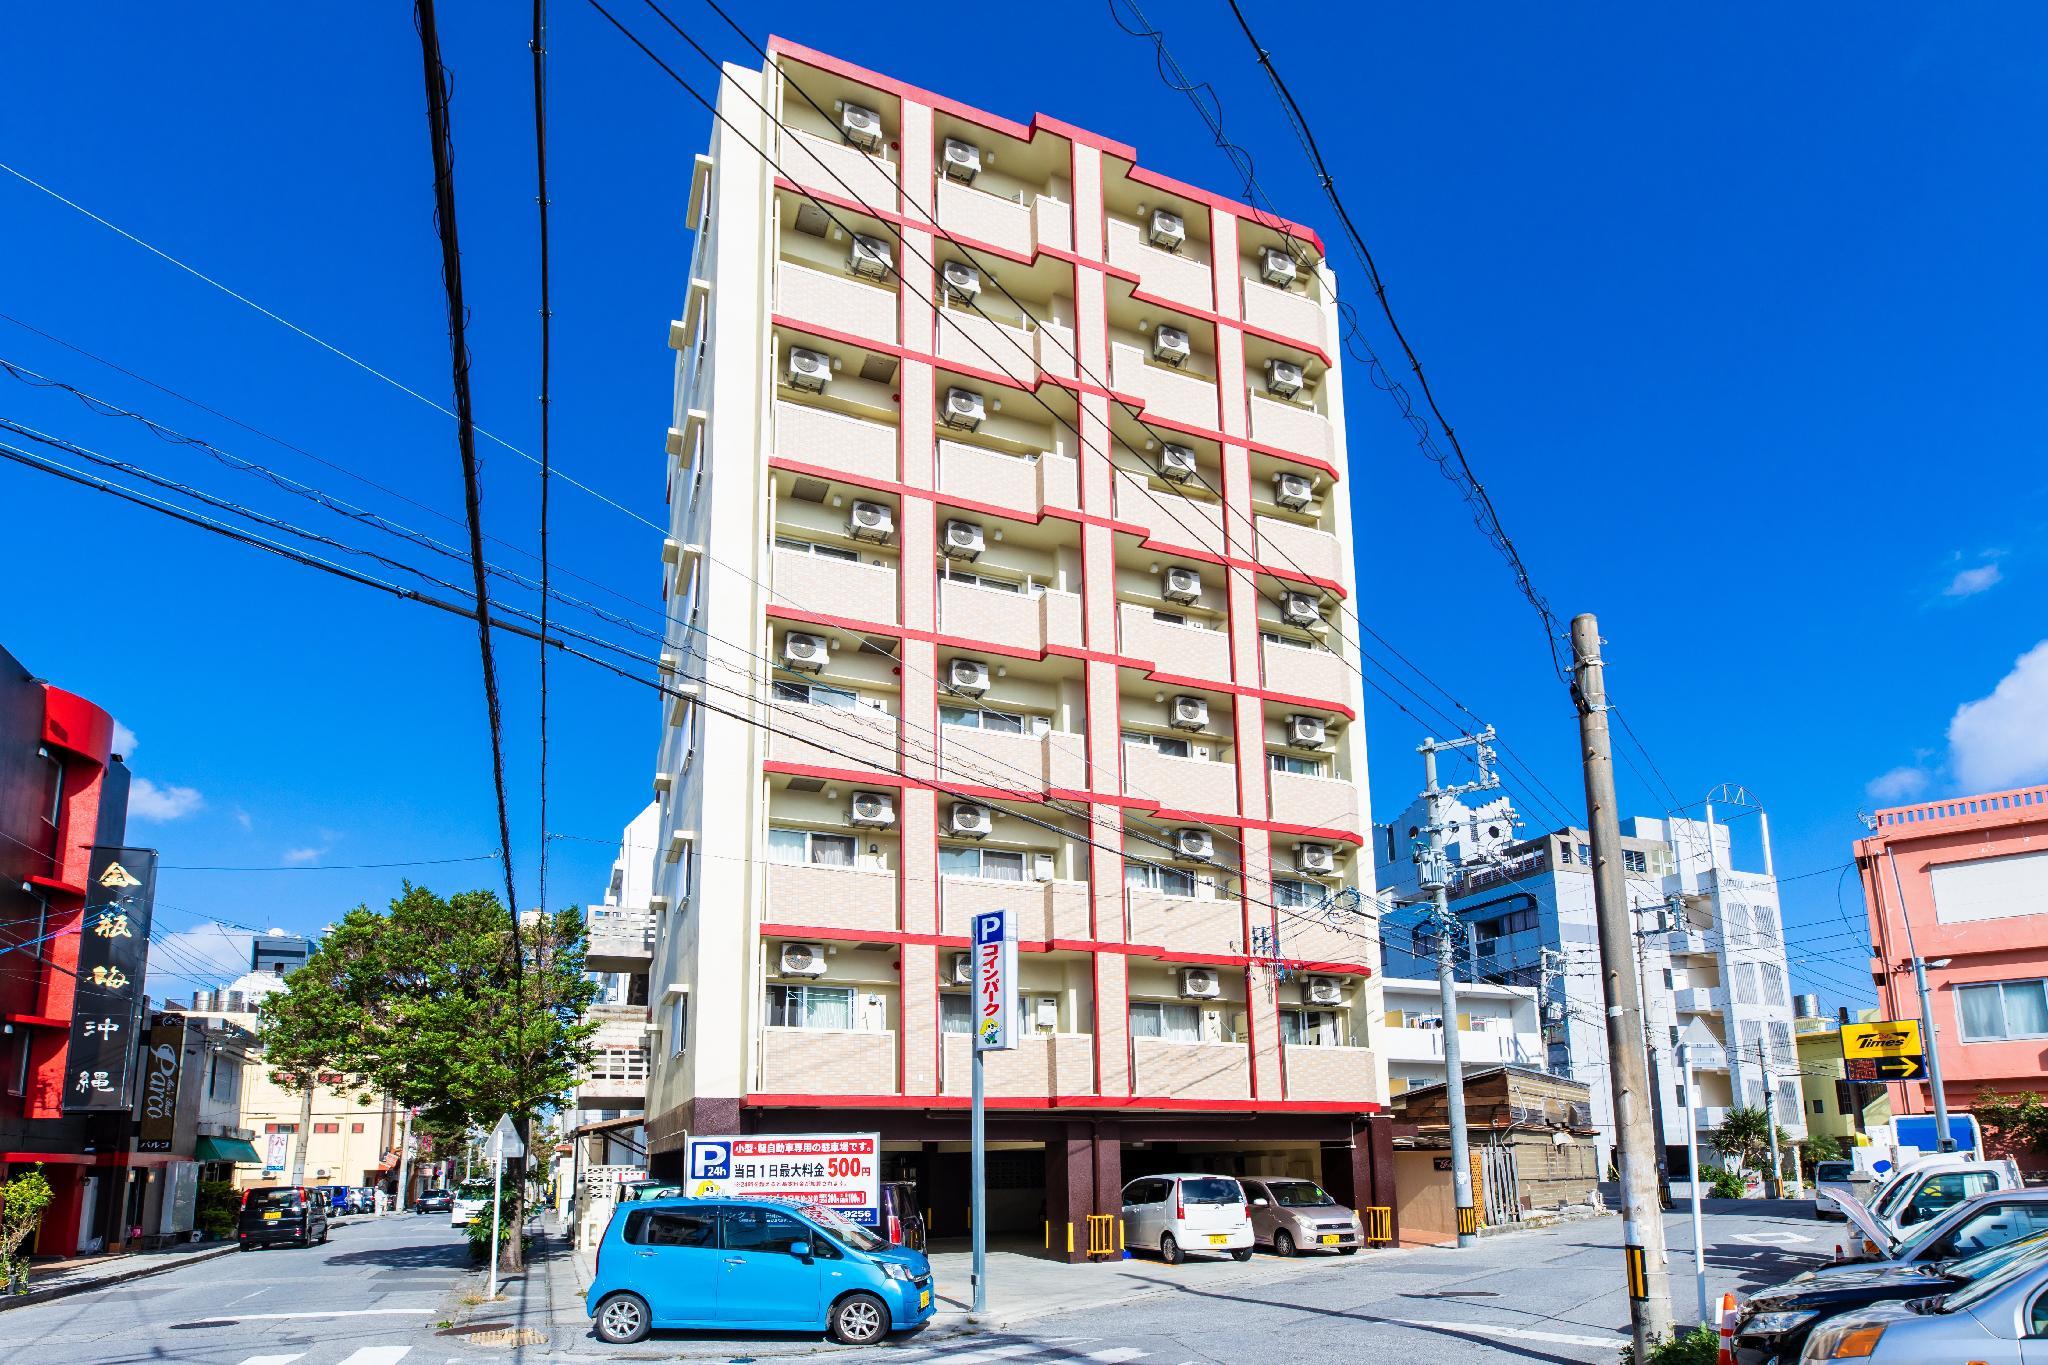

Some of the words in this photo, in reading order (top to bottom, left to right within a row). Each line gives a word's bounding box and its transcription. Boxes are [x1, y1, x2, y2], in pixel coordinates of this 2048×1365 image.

[981, 916, 1000, 941] P
[983, 944, 1000, 1017] コインパーク
[1858, 1035, 1906, 1048] Times
[147, 1043, 178, 1119] Parco
[140, 1141, 169, 1149] パルコ
[695, 1145, 727, 1176] P
[708, 1167, 726, 1176] 24h
